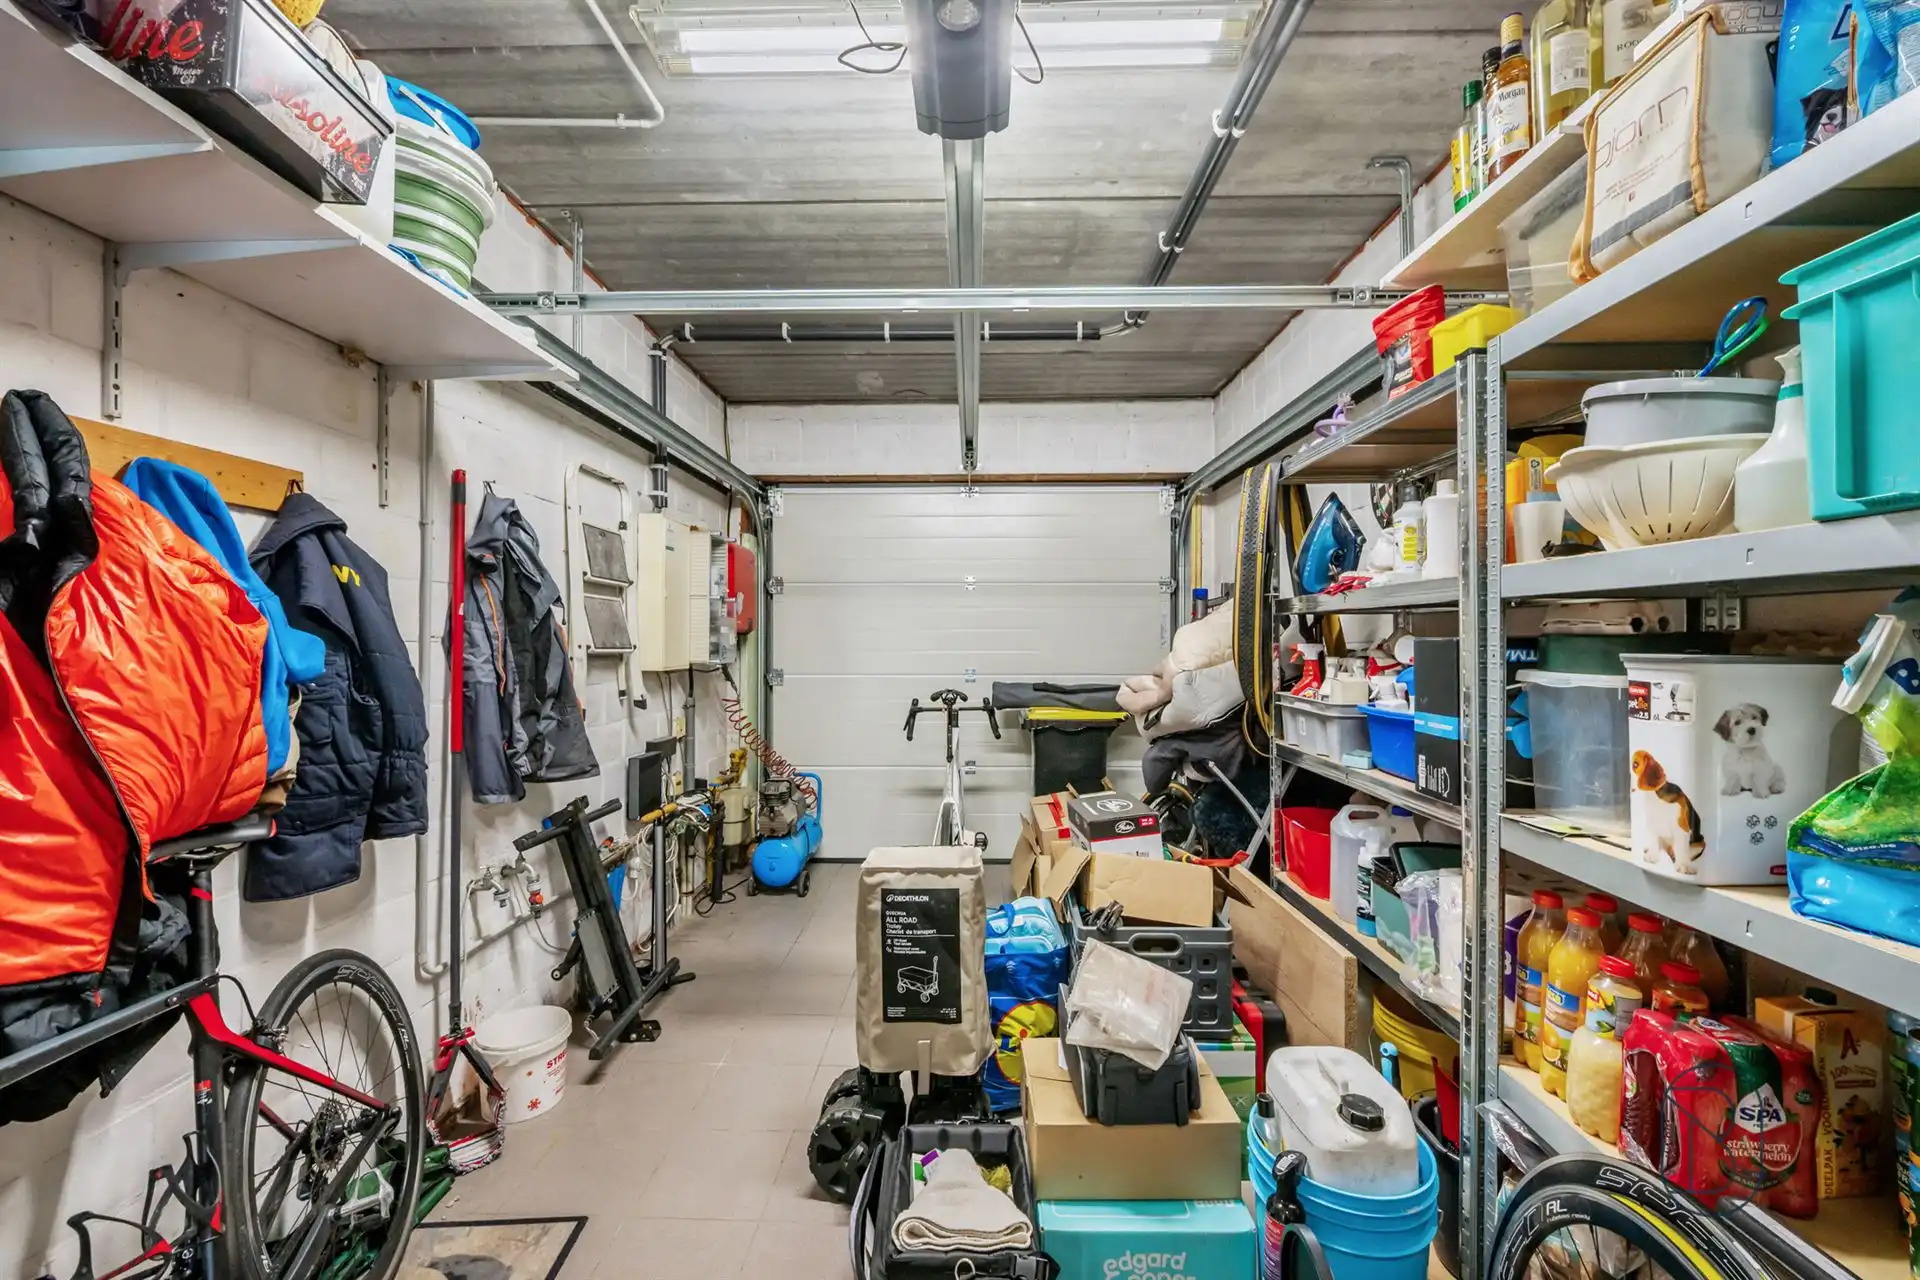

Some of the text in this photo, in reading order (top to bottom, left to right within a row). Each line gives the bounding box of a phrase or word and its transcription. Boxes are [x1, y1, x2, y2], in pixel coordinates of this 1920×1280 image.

[1498, 86, 1526, 102] Morgan
[886, 916, 918, 924] ALL ROAD
[1739, 1106, 1783, 1122] SPA
[1546, 1199, 1568, 1216] AL
[1103, 1249, 1187, 1276] edgard
